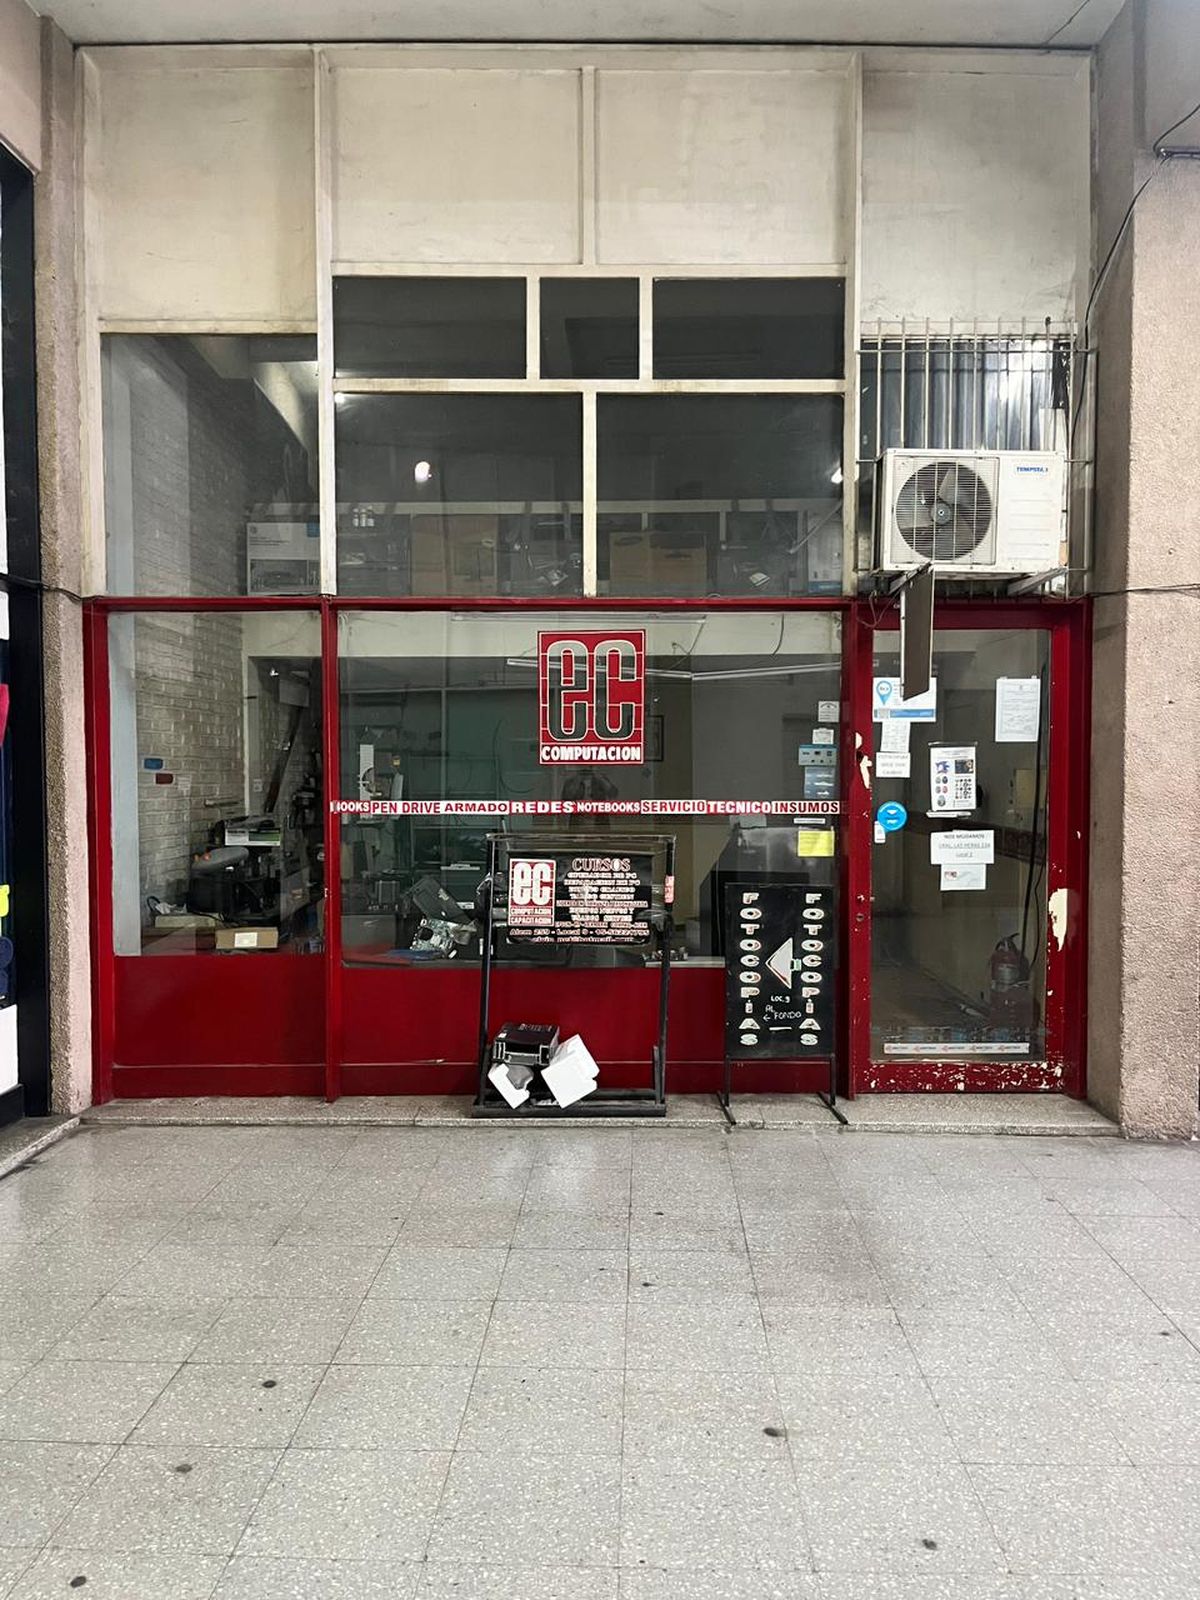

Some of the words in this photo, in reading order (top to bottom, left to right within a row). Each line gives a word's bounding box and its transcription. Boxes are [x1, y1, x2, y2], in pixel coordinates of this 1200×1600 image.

[541, 746, 641, 761] COMPUTACION
[372, 802, 395, 814] PEN
[402, 801, 441, 813] DRIVE
[444, 803, 509, 812] ARMADO
[511, 802, 575, 814] REDES
[577, 803, 640, 813] NOTEBOOKS
[642, 801, 705, 813] SERVICIO
[708, 801, 771, 814] TECNICO
[774, 801, 839, 813] INSUMOS
[572, 858, 631, 871] CURSOS
[774, 1011, 802, 1020] FONDO
